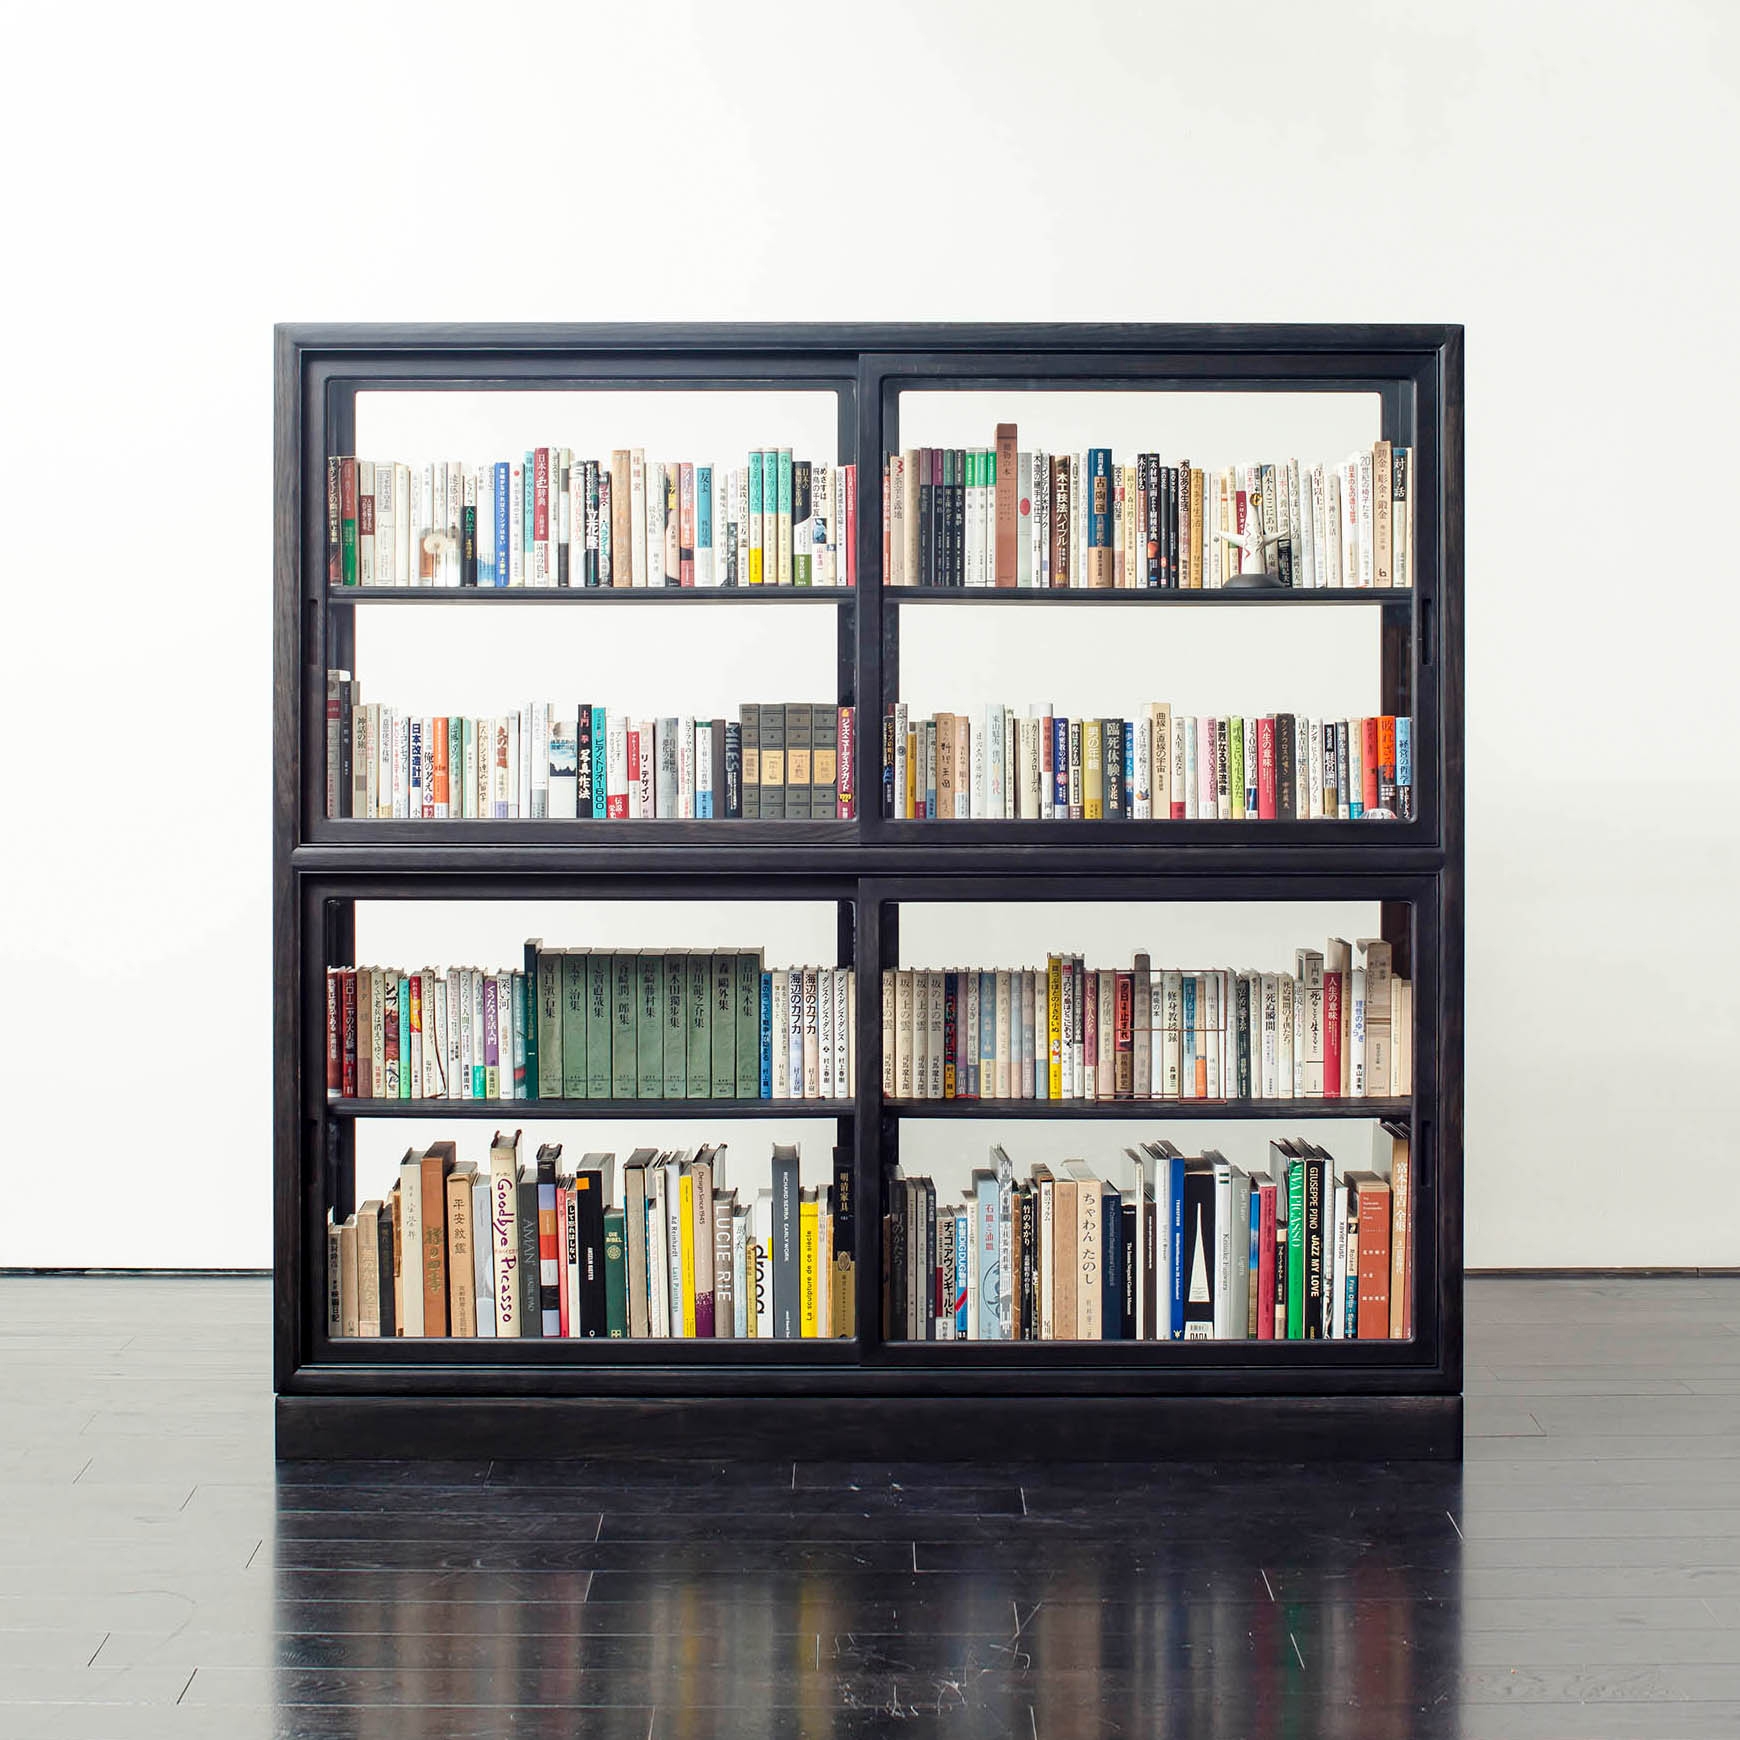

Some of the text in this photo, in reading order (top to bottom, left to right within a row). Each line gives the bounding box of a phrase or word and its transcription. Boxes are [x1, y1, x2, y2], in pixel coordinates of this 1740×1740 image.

[412, 723, 421, 788] 日本改造計画
[578, 748, 591, 799] 写真作法
[726, 723, 739, 772] MILES
[1106, 722, 1120, 776] 臨死体験
[1110, 783, 1118, 810] 立花隆
[499, 978, 510, 1011] 深い河
[618, 962, 630, 1025] 谷崎潤一郎集
[790, 974, 801, 1035] 海辺のカフカ
[806, 974, 816, 1035] 海辺のカフカ
[883, 977, 893, 1030] 坂の上の雲
[900, 977, 912, 1032] 坂の上の雲
[916, 977, 927, 1032] 坂の上の雲
[931, 977, 942, 1032] 坂の上の雲
[1265, 993, 1276, 1031] 死ぬ瞬間
[1328, 977, 1337, 1020] 人生の意味
[1352, 1000, 1364, 1042] 理性のゆらぎ
[1023, 1204, 1031, 1246] 竹のあかり
[1291, 1164, 1302, 1248] VIVA PICASSO
[1309, 1167, 1320, 1297] GIUSEPPE PINO JAZZ MY LOVE
[493, 1178, 516, 1323] Goodbye Picasso
[716, 1205, 731, 1302] LUCIE RIE
[1082, 1192, 1096, 1285] ちゃわん たのし
[944, 1220, 954, 1318] チェコ・アヴァンギャルド
